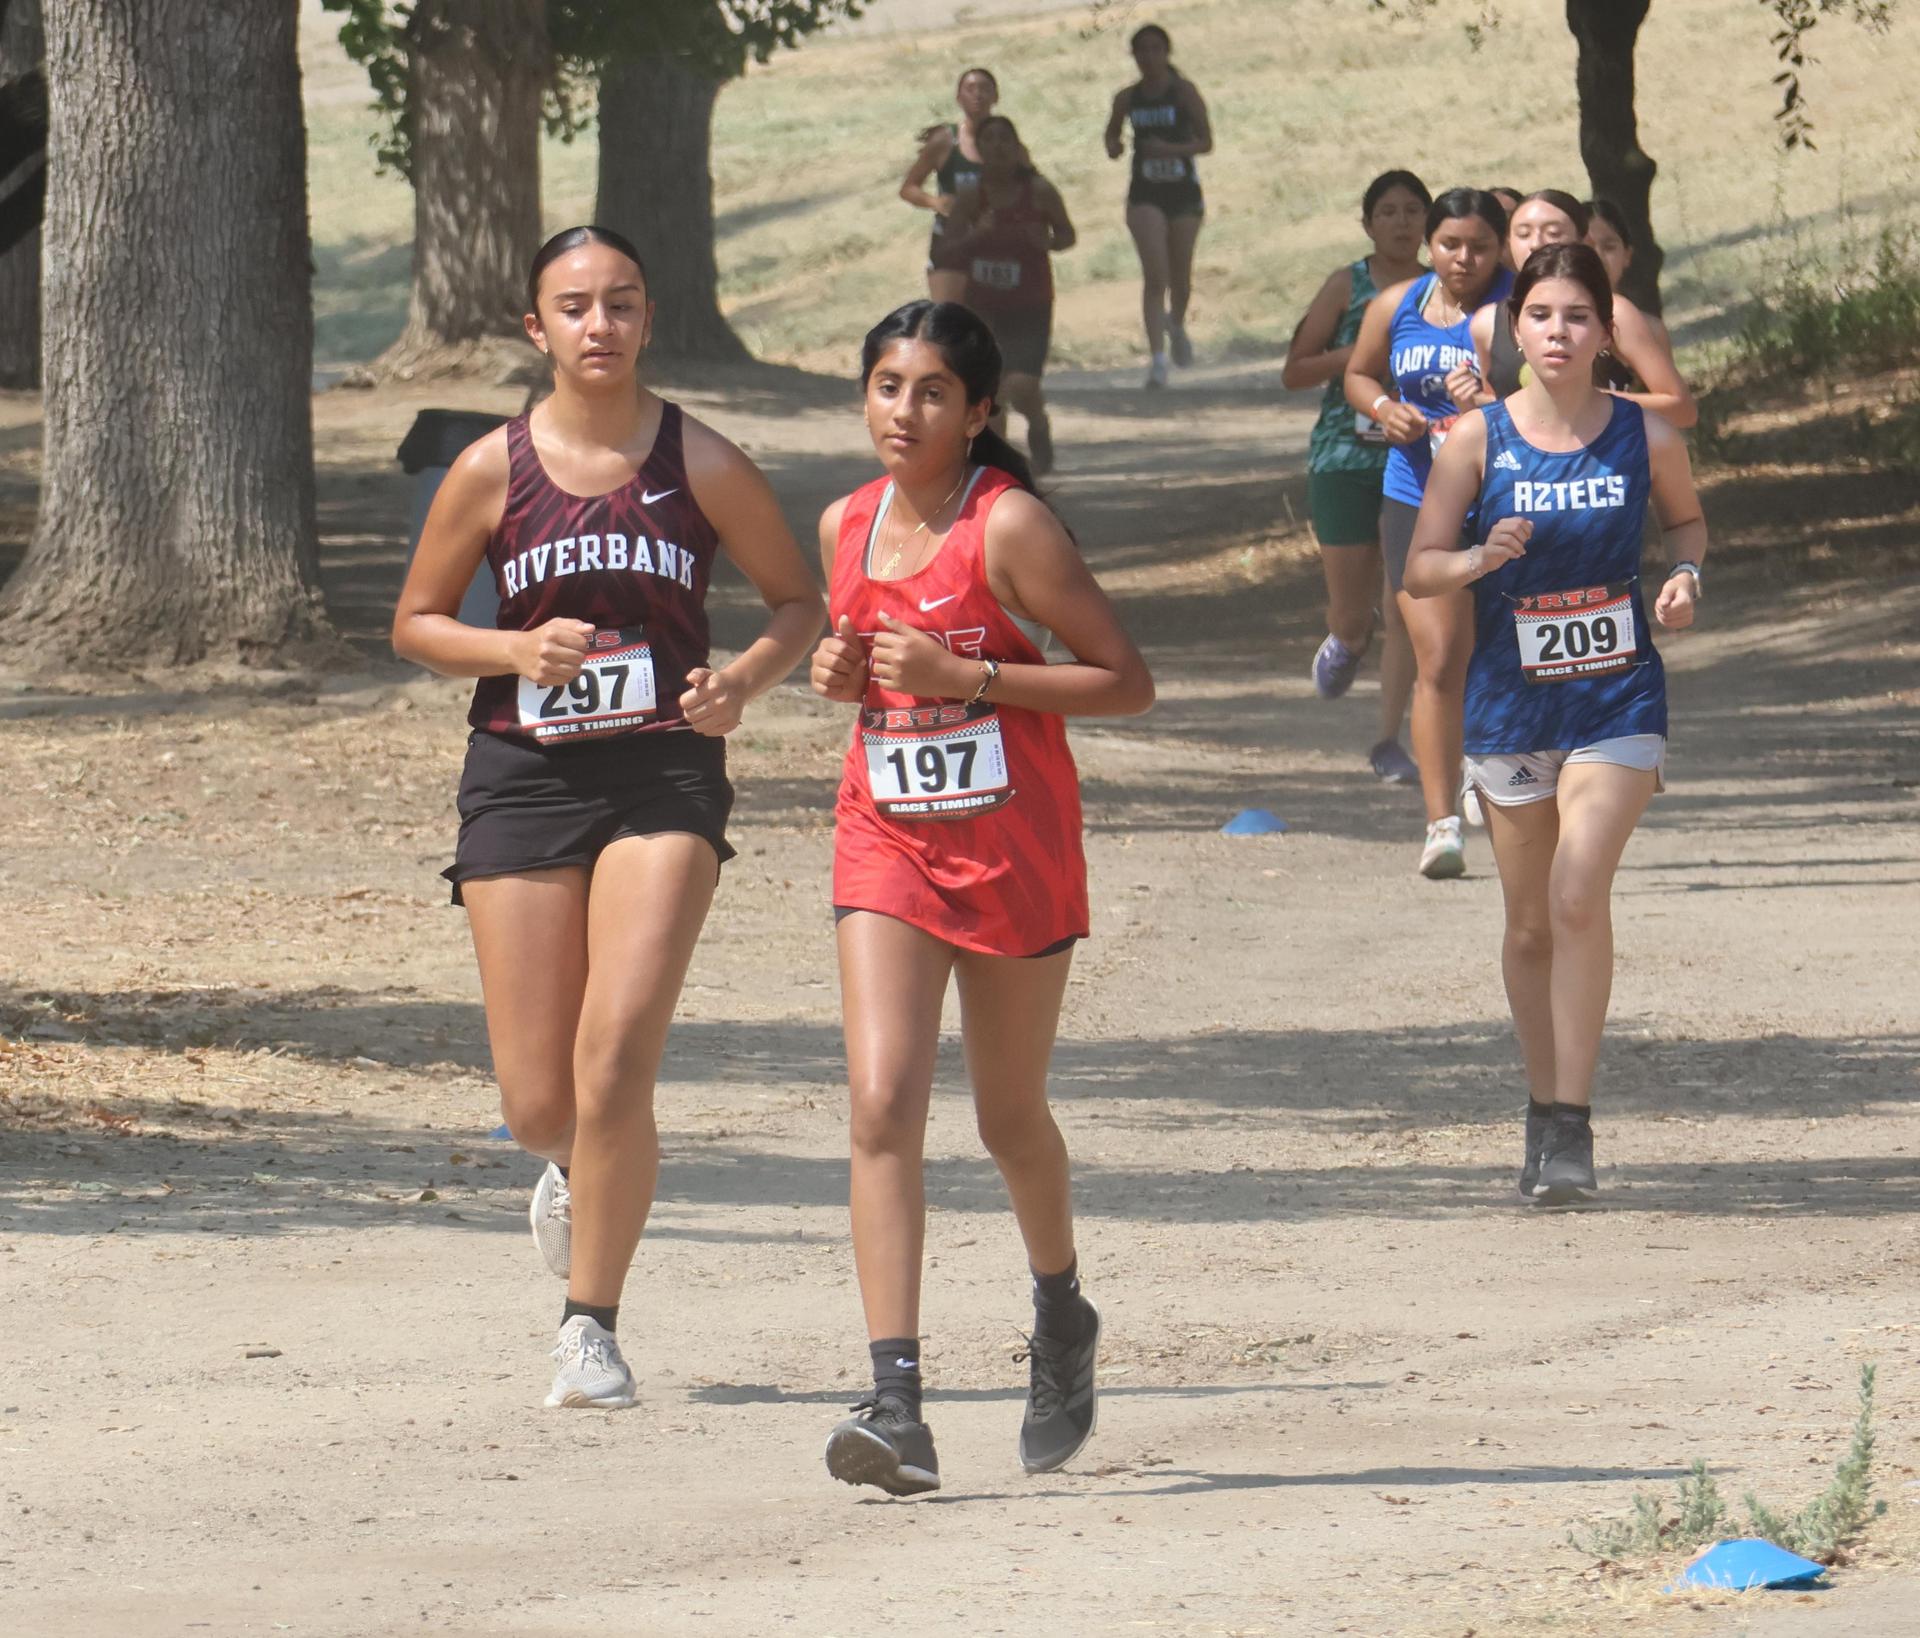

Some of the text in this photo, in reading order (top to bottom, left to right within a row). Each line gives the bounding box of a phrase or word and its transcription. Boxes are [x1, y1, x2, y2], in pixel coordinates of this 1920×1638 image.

[1395, 344, 1436, 377] LADY
[1514, 475, 1625, 512] AZTECS
[503, 533, 695, 599] RIVERBANK
[1537, 586, 1608, 609] RTS
[1536, 616, 1618, 662] 209
[1536, 664, 1574, 676] RACE
[1576, 656, 1627, 672] TIMING
[536, 664, 630, 719] 297
[535, 723, 580, 737] RACE
[581, 715, 644, 732] TIMING
[886, 704, 968, 728] RTS
[886, 740, 978, 794] 197
[1508, 777, 1538, 786] adidas
[889, 802, 929, 813] RACE
[930, 794, 996, 812] TIMING
